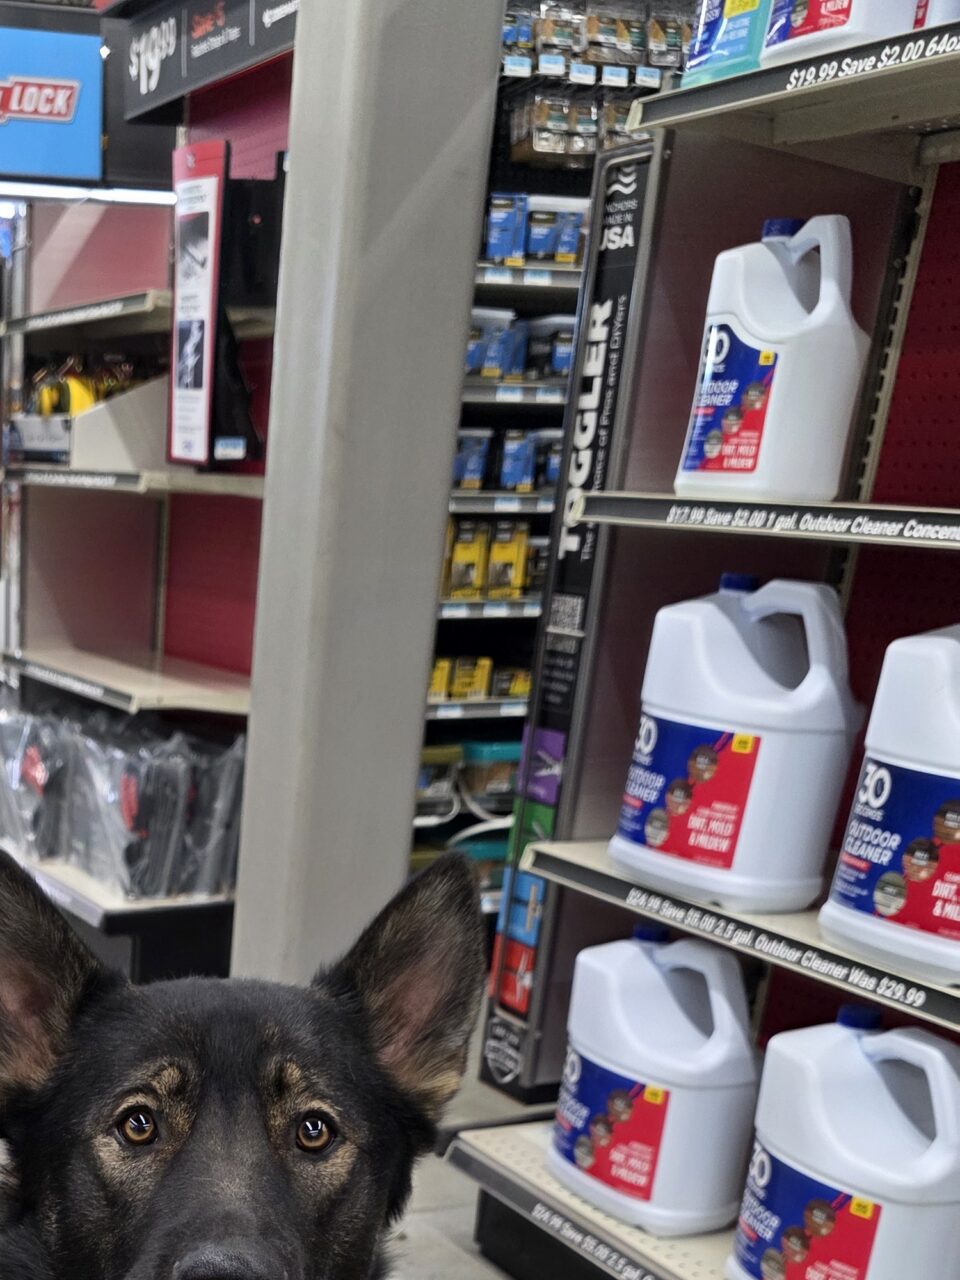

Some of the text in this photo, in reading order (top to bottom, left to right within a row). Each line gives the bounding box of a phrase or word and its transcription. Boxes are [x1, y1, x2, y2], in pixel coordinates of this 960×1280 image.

[786, 60, 839, 91] $19.99
[838, 55, 877, 78] Save
[877, 39, 925, 70] $2.00
[557, 298, 613, 561] TOGGLER
[703, 507, 733, 526] Save
[731, 507, 768, 528] $2.00
[766, 511, 777, 528] 1
[773, 511, 798, 532] gal.
[799, 512, 852, 533] Outdoor
[850, 515, 903, 536] Cleaner
[857, 762, 892, 809] 30
[848, 818, 902, 850] OUTDOOR
[844, 835, 894, 866] CLEANER
[931, 879, 958, 904] DIRT,
[932, 899, 944, 917] &
[658, 899, 686, 921] Save
[713, 918, 737, 940] 2.5
[731, 929, 754, 947] gal.
[754, 932, 803, 963] Outdoor
[800, 949, 849, 980] Cleaner
[847, 965, 879, 991] Was
[876, 975, 927, 1008] $29.99
[605, 1251, 628, 1272] 2.5
